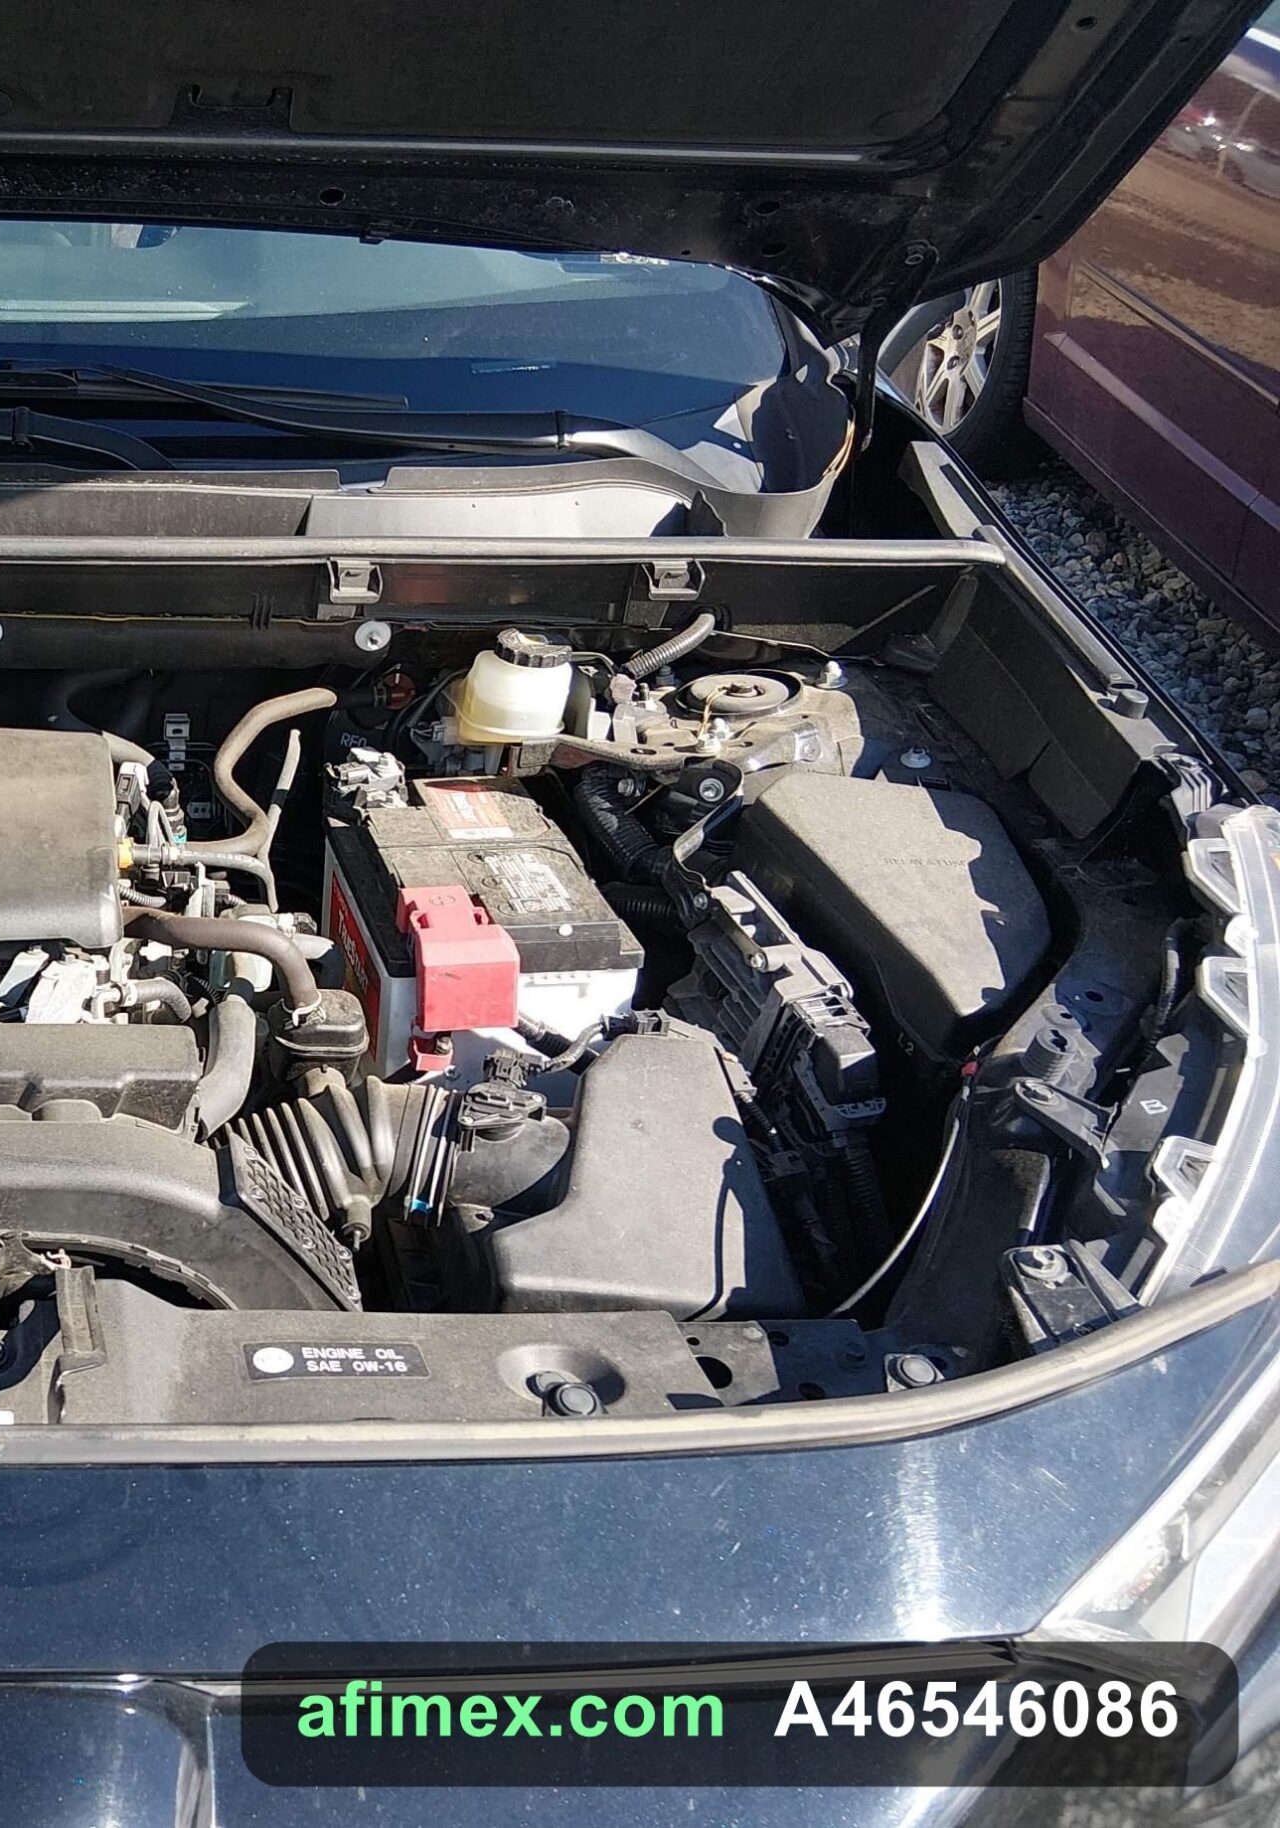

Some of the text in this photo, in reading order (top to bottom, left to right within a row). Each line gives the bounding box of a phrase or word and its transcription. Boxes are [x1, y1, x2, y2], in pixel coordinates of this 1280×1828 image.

[301, 1347, 405, 1360] ENGINE OIL
[306, 1360, 408, 1372] SAE 0W-16
